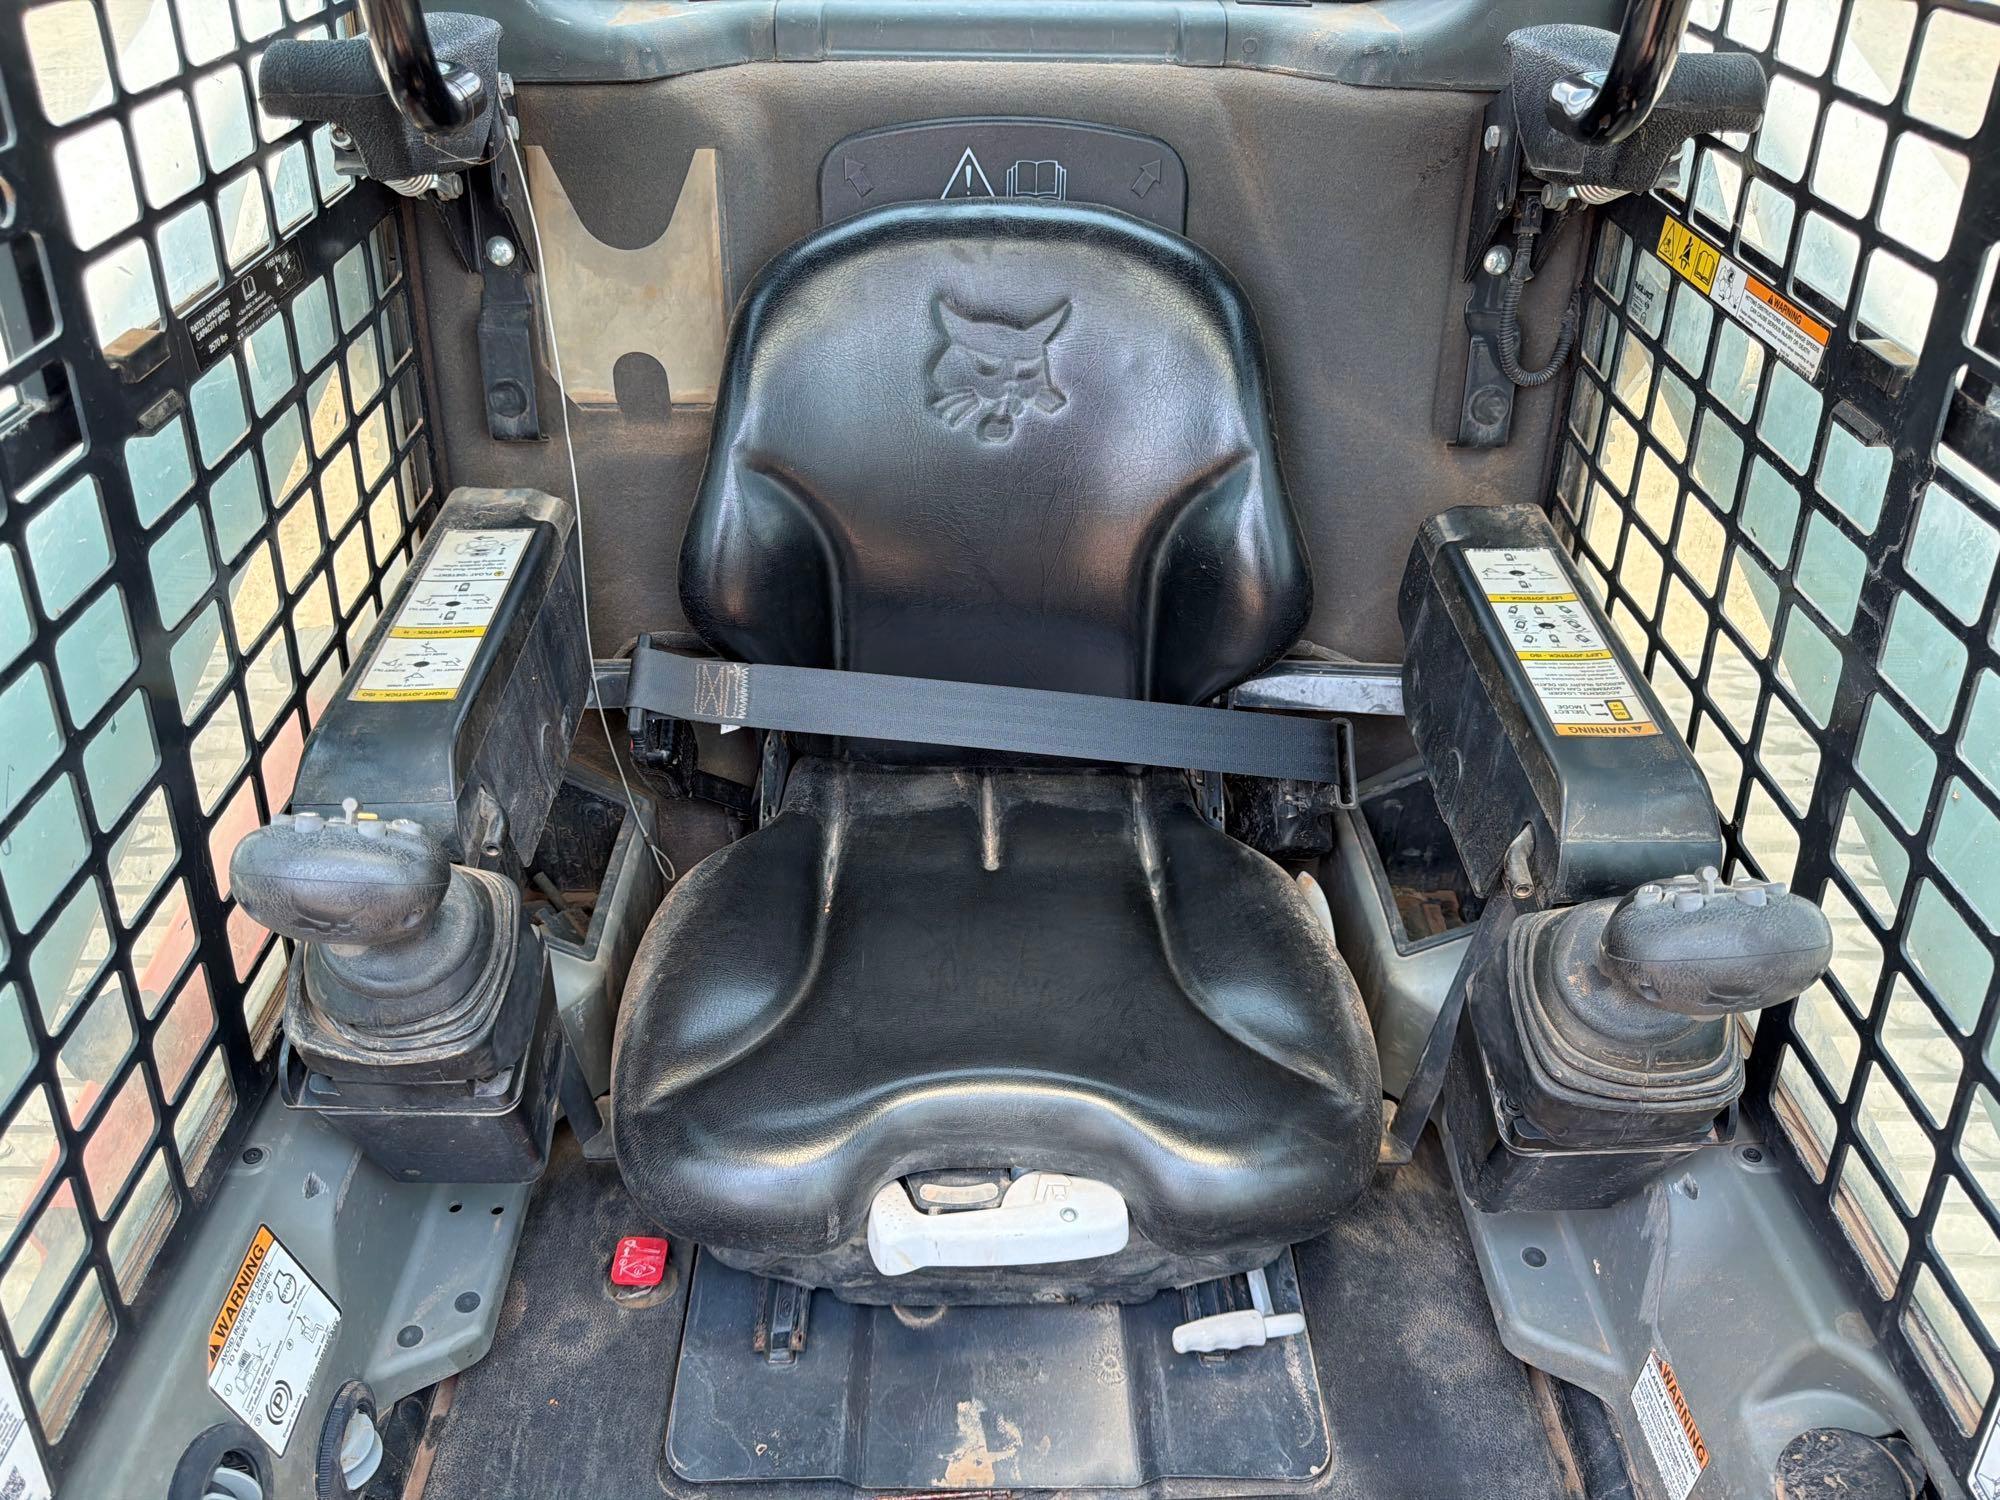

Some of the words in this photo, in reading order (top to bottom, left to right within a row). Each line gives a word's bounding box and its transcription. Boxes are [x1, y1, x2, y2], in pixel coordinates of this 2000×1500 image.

[189, 315, 206, 335] RATED
[204, 296, 230, 322] OPERATING
[195, 317, 218, 342] CAPACITY
[217, 307, 231, 325] (ROC)
[219, 330, 228, 344] lbs
[1773, 297, 1802, 325] WARNING
[213, 1241, 265, 1341] WARNING
[220, 1336, 234, 1364] AVOID
[232, 1303, 249, 1336] INJURY
[254, 1261, 268, 1289] DEATH
[233, 1324, 248, 1353] LEAVE
[246, 1305, 256, 1324] THE
[254, 1268, 273, 1306] LOADER:
[280, 1276, 293, 1301] STOP
[1646, 1361, 1663, 1400] ALARM
[1662, 1399, 1678, 1433] MUST
[1676, 1433, 1697, 1480] SOUND!
[1661, 1364, 1706, 1463] WARNING
